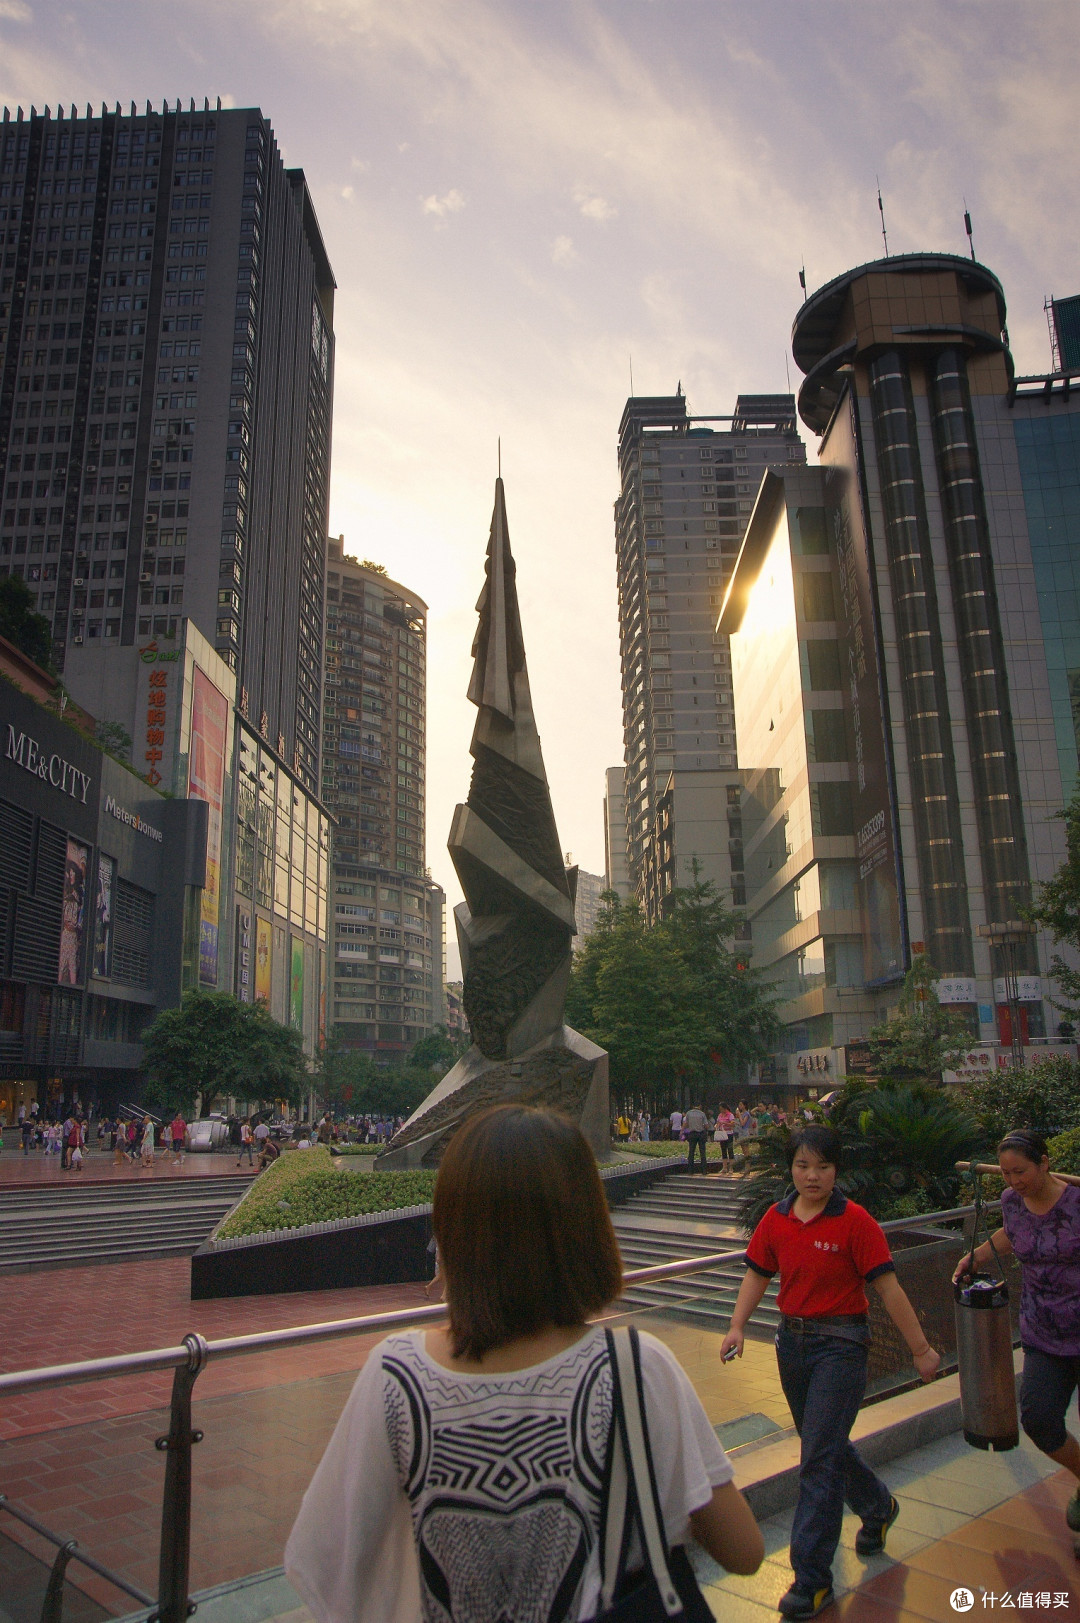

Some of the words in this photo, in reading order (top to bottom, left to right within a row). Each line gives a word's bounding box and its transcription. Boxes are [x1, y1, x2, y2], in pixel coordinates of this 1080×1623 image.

[5, 723, 92, 805] ME&CITY
[144, 669, 168, 786] 炫地购物中心
